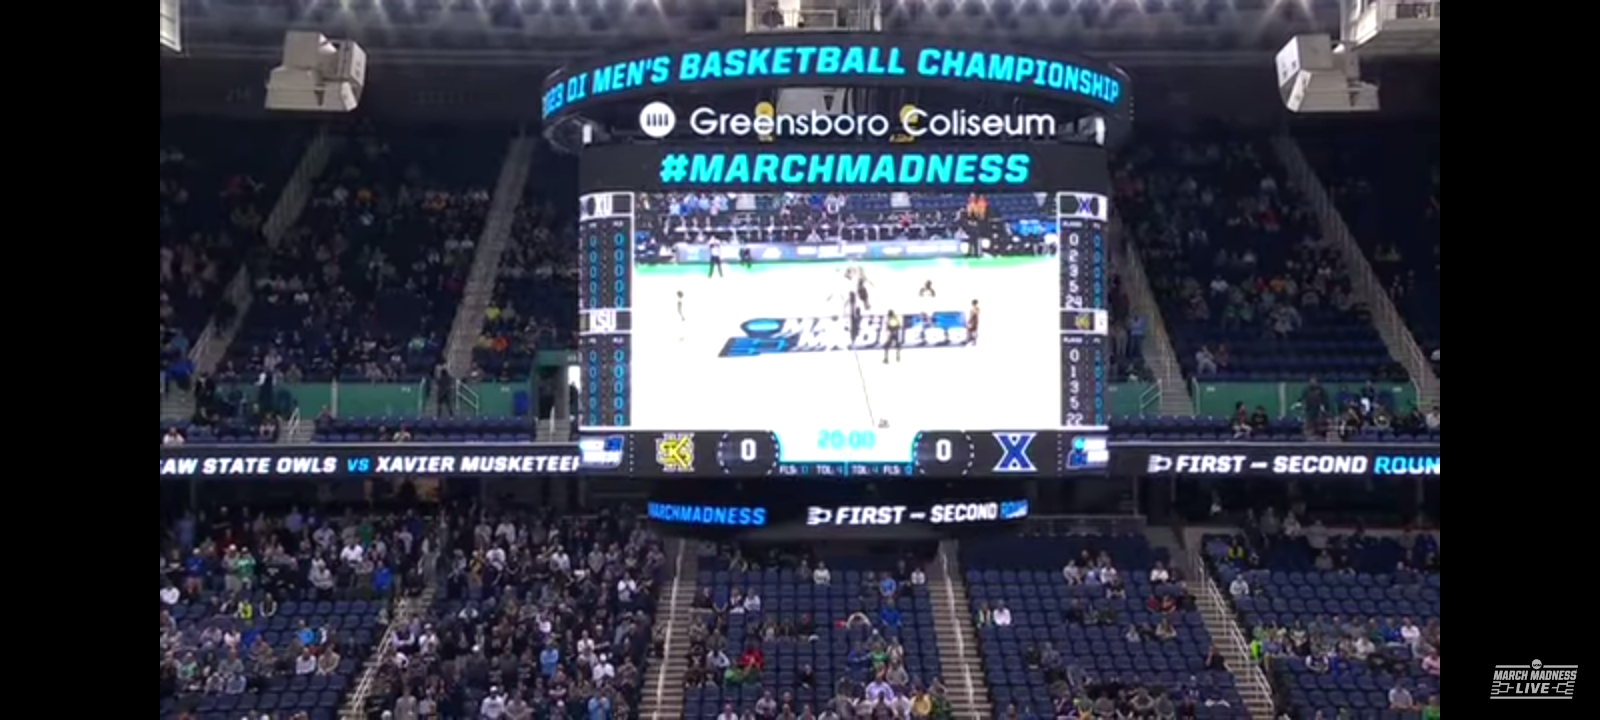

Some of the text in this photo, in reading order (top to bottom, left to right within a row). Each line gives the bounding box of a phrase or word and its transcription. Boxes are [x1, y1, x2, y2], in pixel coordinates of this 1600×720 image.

[566, 73, 588, 103] DI
[592, 56, 671, 95] MEN'S
[678, 46, 906, 81] BASKETBALL
[917, 48, 1120, 103] CHAMPIONSHIP
[690, 106, 1056, 136] Greensboro Coliseum
[659, 154, 1030, 184] #MARCHMADNESS
[614, 232, 625, 246] 0
[1069, 233, 1079, 246] 0
[614, 249, 625, 262] 0
[1069, 249, 1079, 262] 2
[614, 264, 625, 277] 0
[1069, 264, 1079, 277] 3
[614, 280, 625, 293] 0
[1069, 280, 1079, 293] 5
[614, 296, 625, 309] 0
[614, 350, 625, 362] 0
[1069, 348, 1080, 362] 0
[614, 365, 625, 379] 0
[1070, 365, 1077, 378] 1
[614, 381, 625, 394] 0
[1069, 380, 1079, 394] 3
[614, 396, 625, 410] 0
[1069, 395, 1079, 410] 5
[614, 412, 625, 426] 0
[817, 429, 877, 450] 20:00
[740, 438, 757, 461] 0
[936, 439, 952, 462] 0
[992, 432, 1038, 472] X
[160, 458, 198, 474] AW
[202, 457, 271, 474] STATE
[276, 456, 337, 473] OWLS
[348, 457, 370, 472] VS
[375, 455, 456, 473] XAVIER
[1175, 455, 1246, 473] FIRST
[1273, 455, 1368, 473] SECOND
[836, 506, 906, 524] FIRST
[930, 503, 998, 523] SECOND
